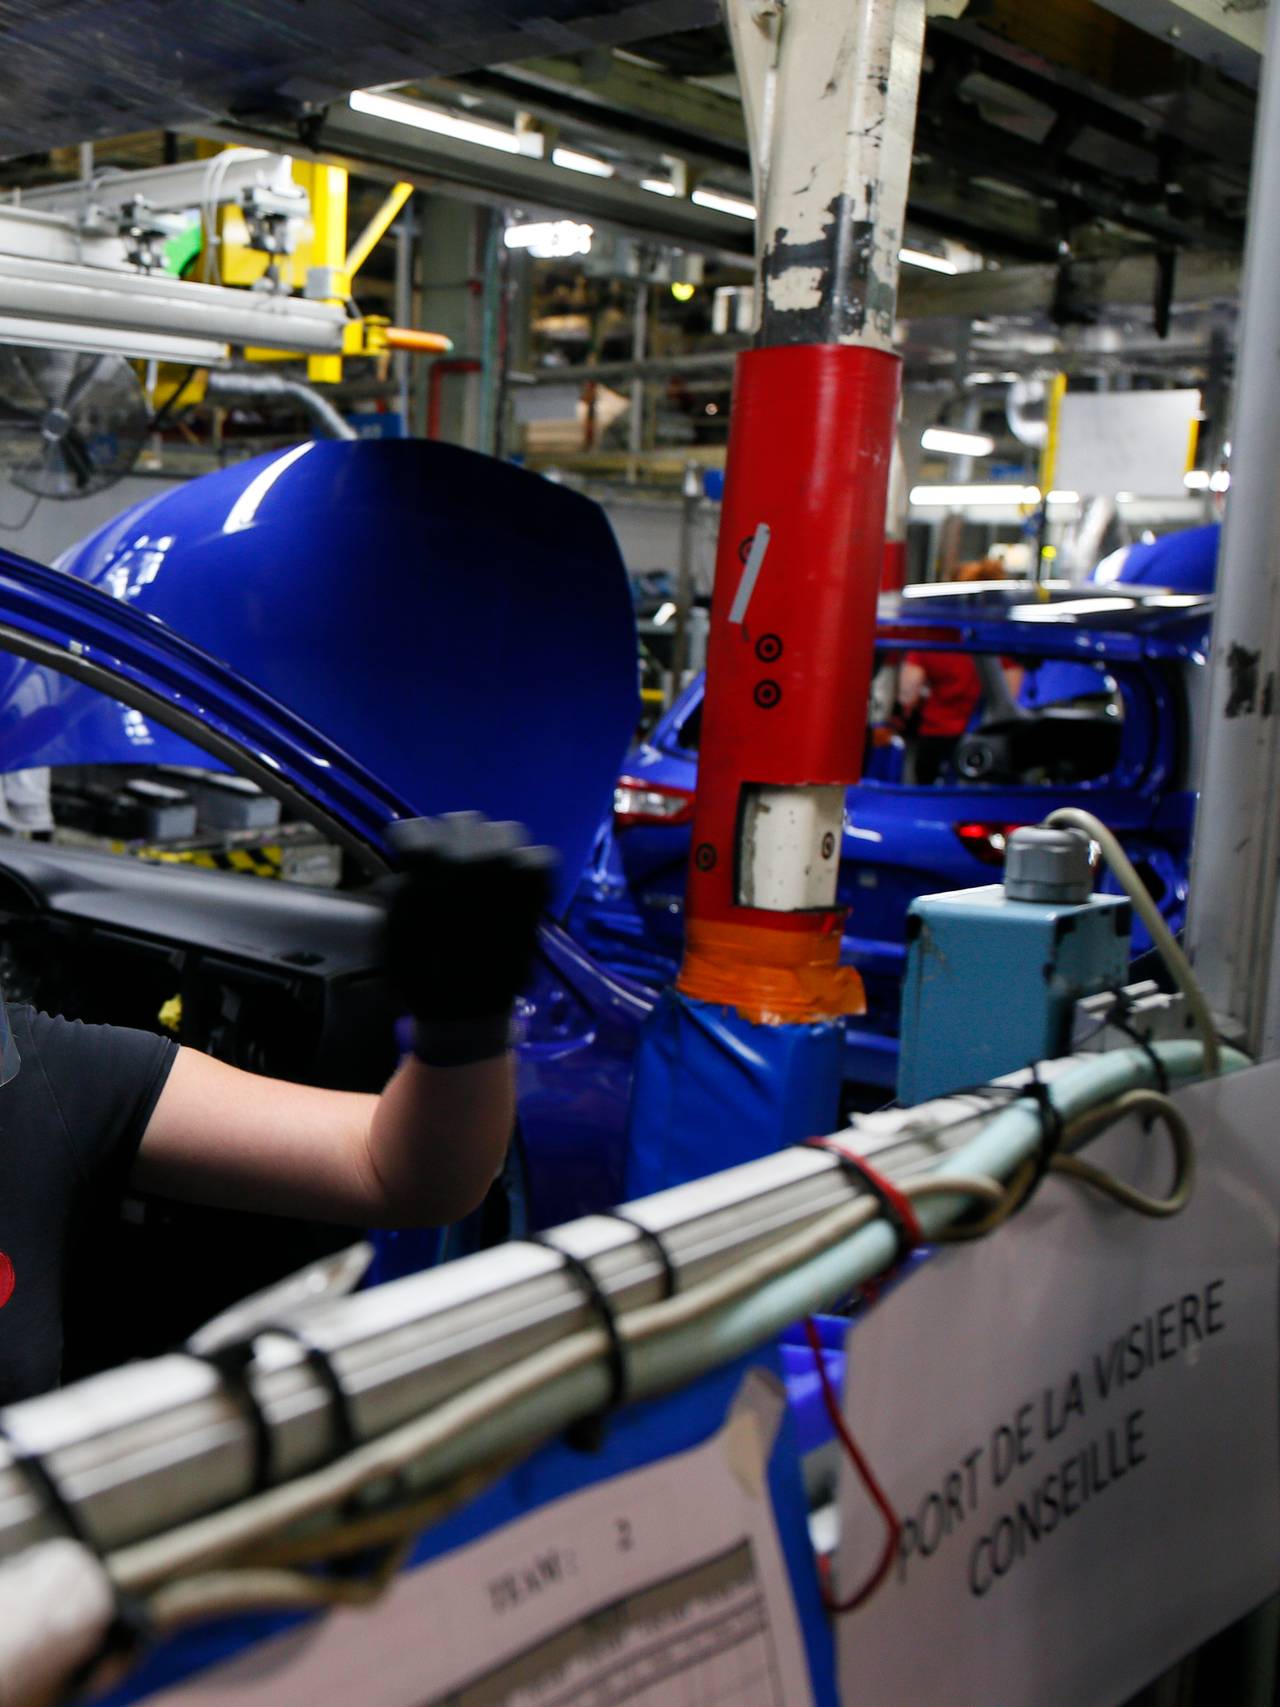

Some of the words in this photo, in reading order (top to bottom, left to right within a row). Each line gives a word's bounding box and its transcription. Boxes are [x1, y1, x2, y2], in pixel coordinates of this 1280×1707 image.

[898, 1446, 985, 1585] PORT
[993, 1402, 1035, 1488] DE
[1044, 1369, 1085, 1441] LA
[1094, 1278, 1227, 1402] VISIERE
[969, 1409, 1148, 1598] CONSEILLE
[614, 1516, 634, 1553] 2
